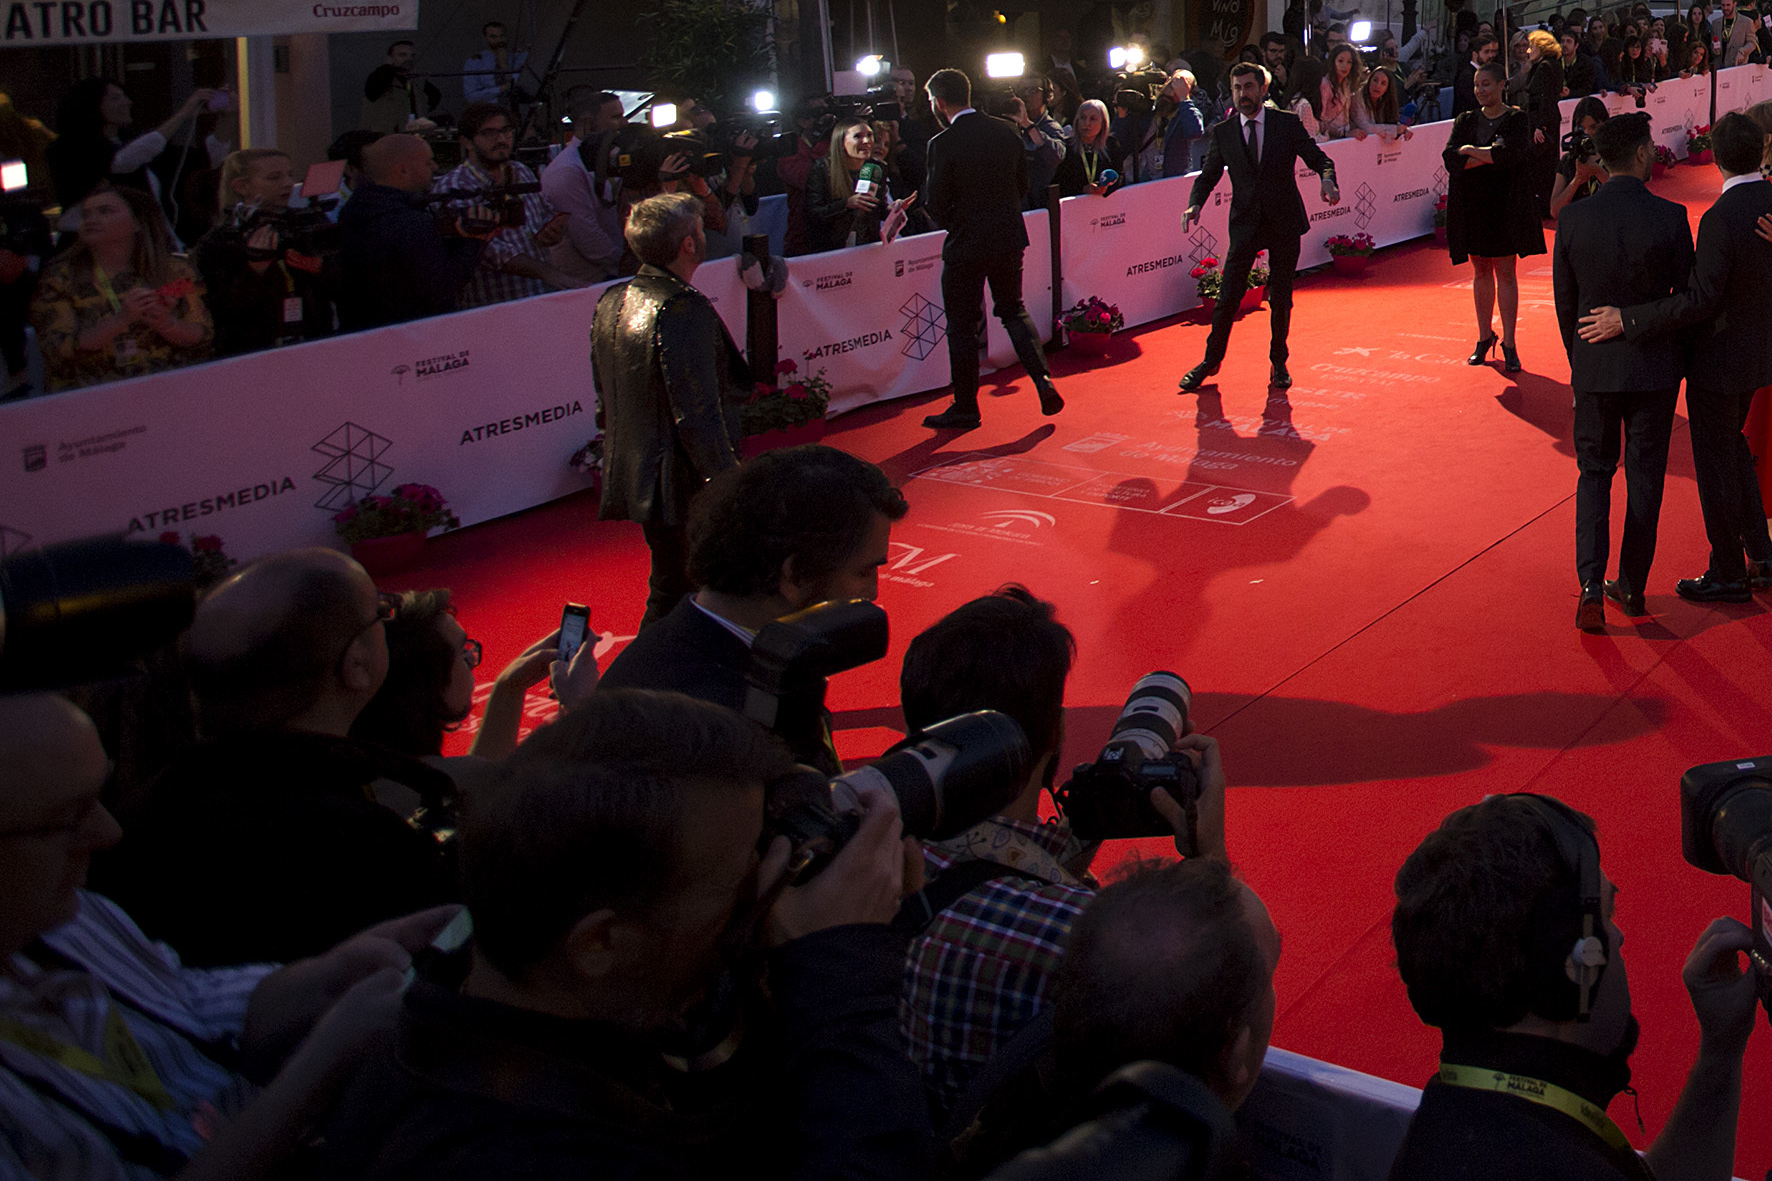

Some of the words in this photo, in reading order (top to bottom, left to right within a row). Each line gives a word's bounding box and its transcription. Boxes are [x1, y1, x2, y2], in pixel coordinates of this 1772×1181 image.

[312, 3, 400, 19] Cruzcampo
[1393, 187, 1430, 203] ATRESMEDIA
[1310, 205, 1351, 223] ATRESMEDIA
[1126, 254, 1183, 278] ATRESMEDIA
[813, 328, 892, 359] ATRESMEDIA
[1310, 363, 1441, 384] Cruzcampo
[460, 400, 583, 446] ATRESMEDIA
[128, 476, 296, 534] ATRESMEDIA
